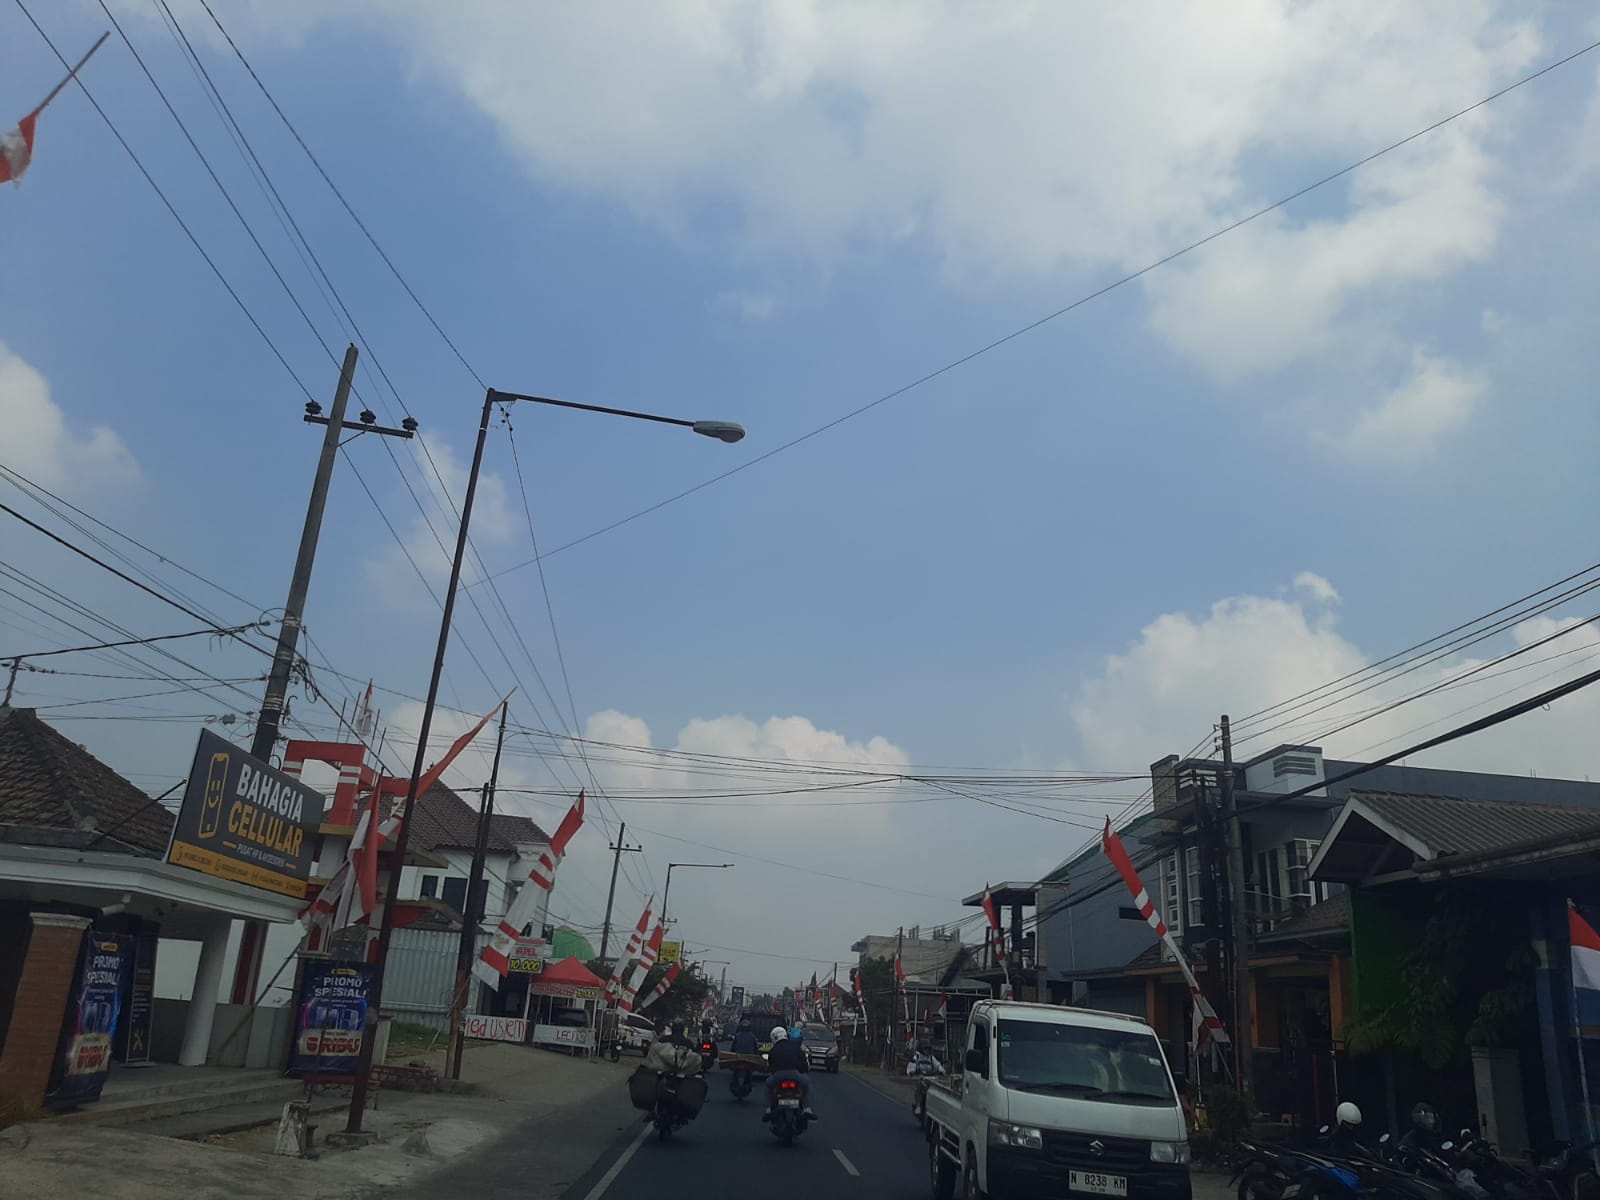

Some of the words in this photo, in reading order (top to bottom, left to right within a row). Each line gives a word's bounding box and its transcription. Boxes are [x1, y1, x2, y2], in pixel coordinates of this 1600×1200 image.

[236, 763, 304, 823] BAHAGIA
[228, 801, 304, 857] CELLULAR
[93, 955, 120, 970] PROMO
[510, 960, 542, 972] 10.000
[323, 977, 363, 988] PROMO
[1071, 1173, 1077, 1184] N
[1114, 1178, 1125, 1190] KM
